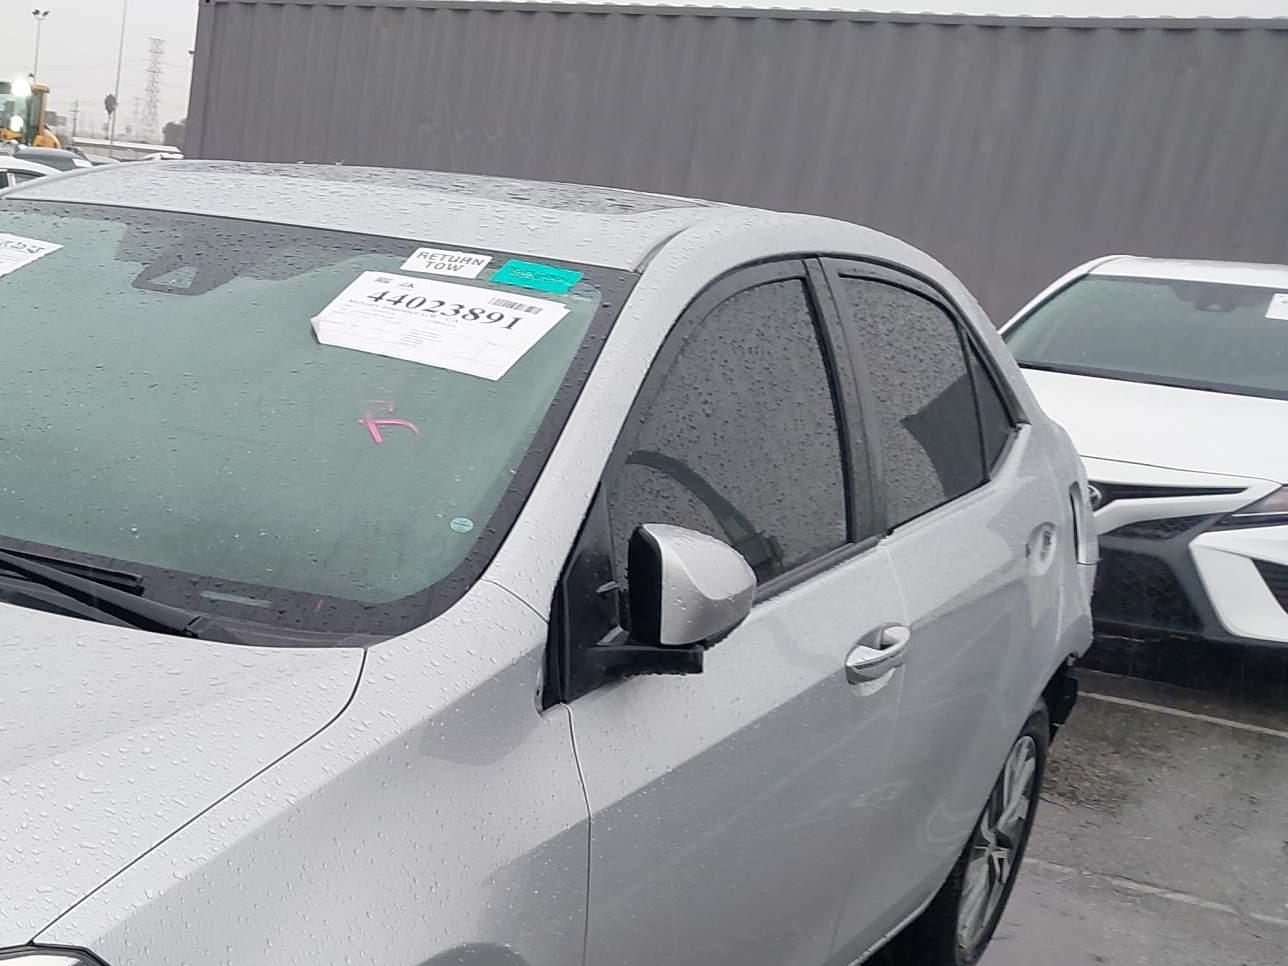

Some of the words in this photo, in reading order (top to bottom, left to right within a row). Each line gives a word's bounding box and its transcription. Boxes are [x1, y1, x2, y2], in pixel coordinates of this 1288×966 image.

[416, 251, 485, 266] RETURN
[424, 261, 465, 272] TOW
[366, 290, 523, 331] 44023891
